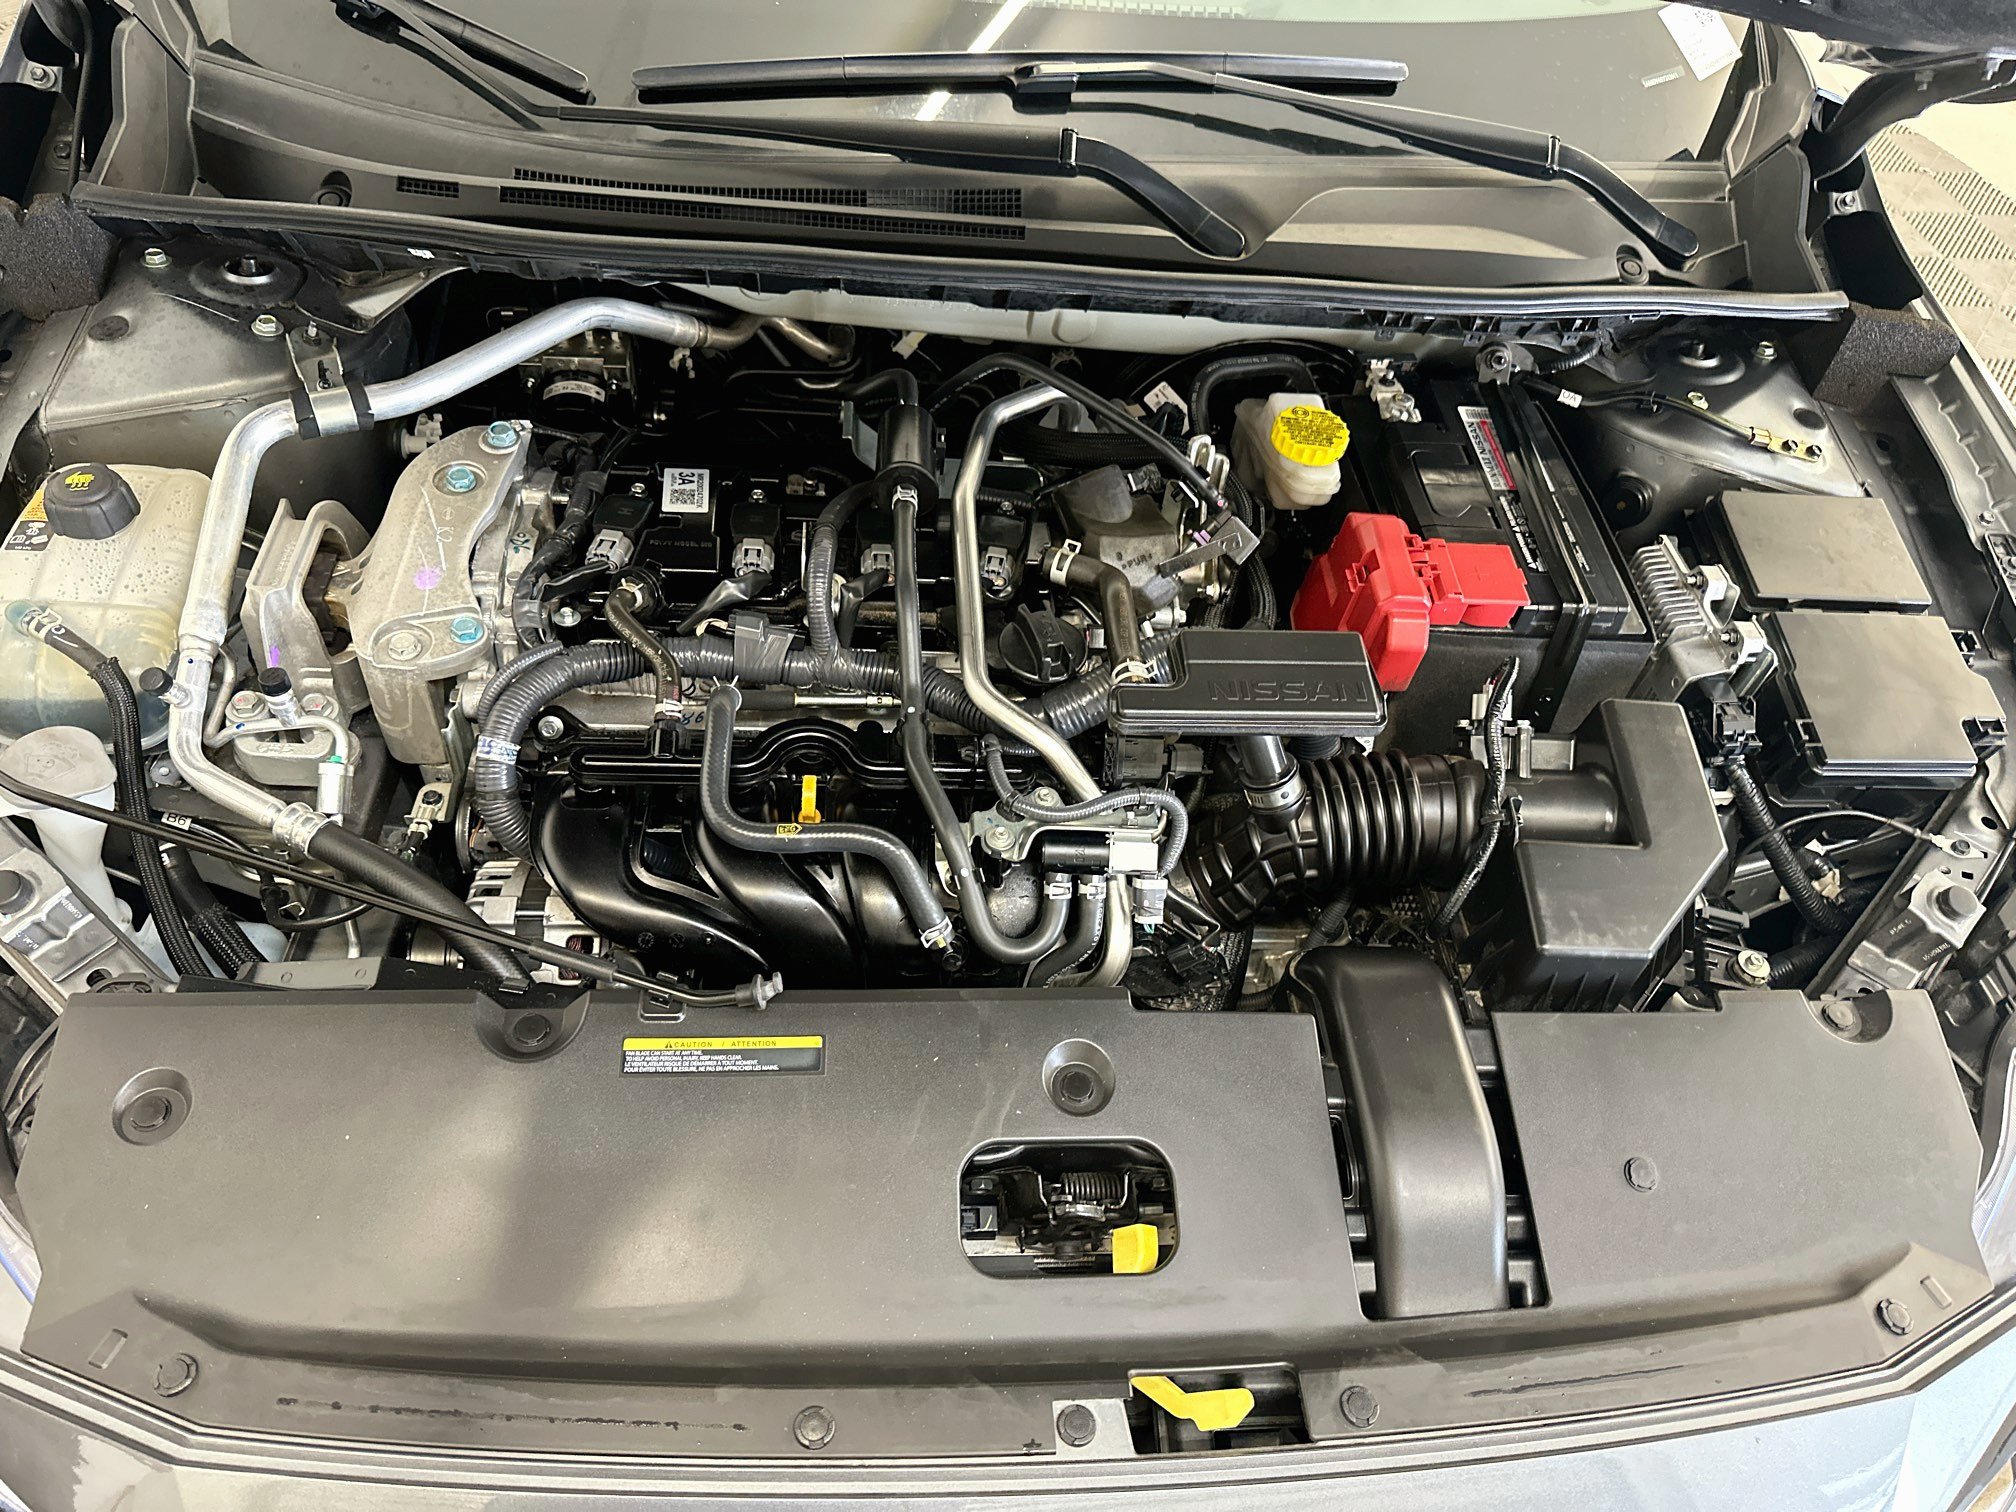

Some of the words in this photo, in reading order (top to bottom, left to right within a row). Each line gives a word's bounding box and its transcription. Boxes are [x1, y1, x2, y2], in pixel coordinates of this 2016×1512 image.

[1466, 421, 1487, 455] NISSAN
[678, 472, 695, 485] 3A
[1208, 680, 1368, 702] NISSAN
[167, 812, 188, 826] B6
